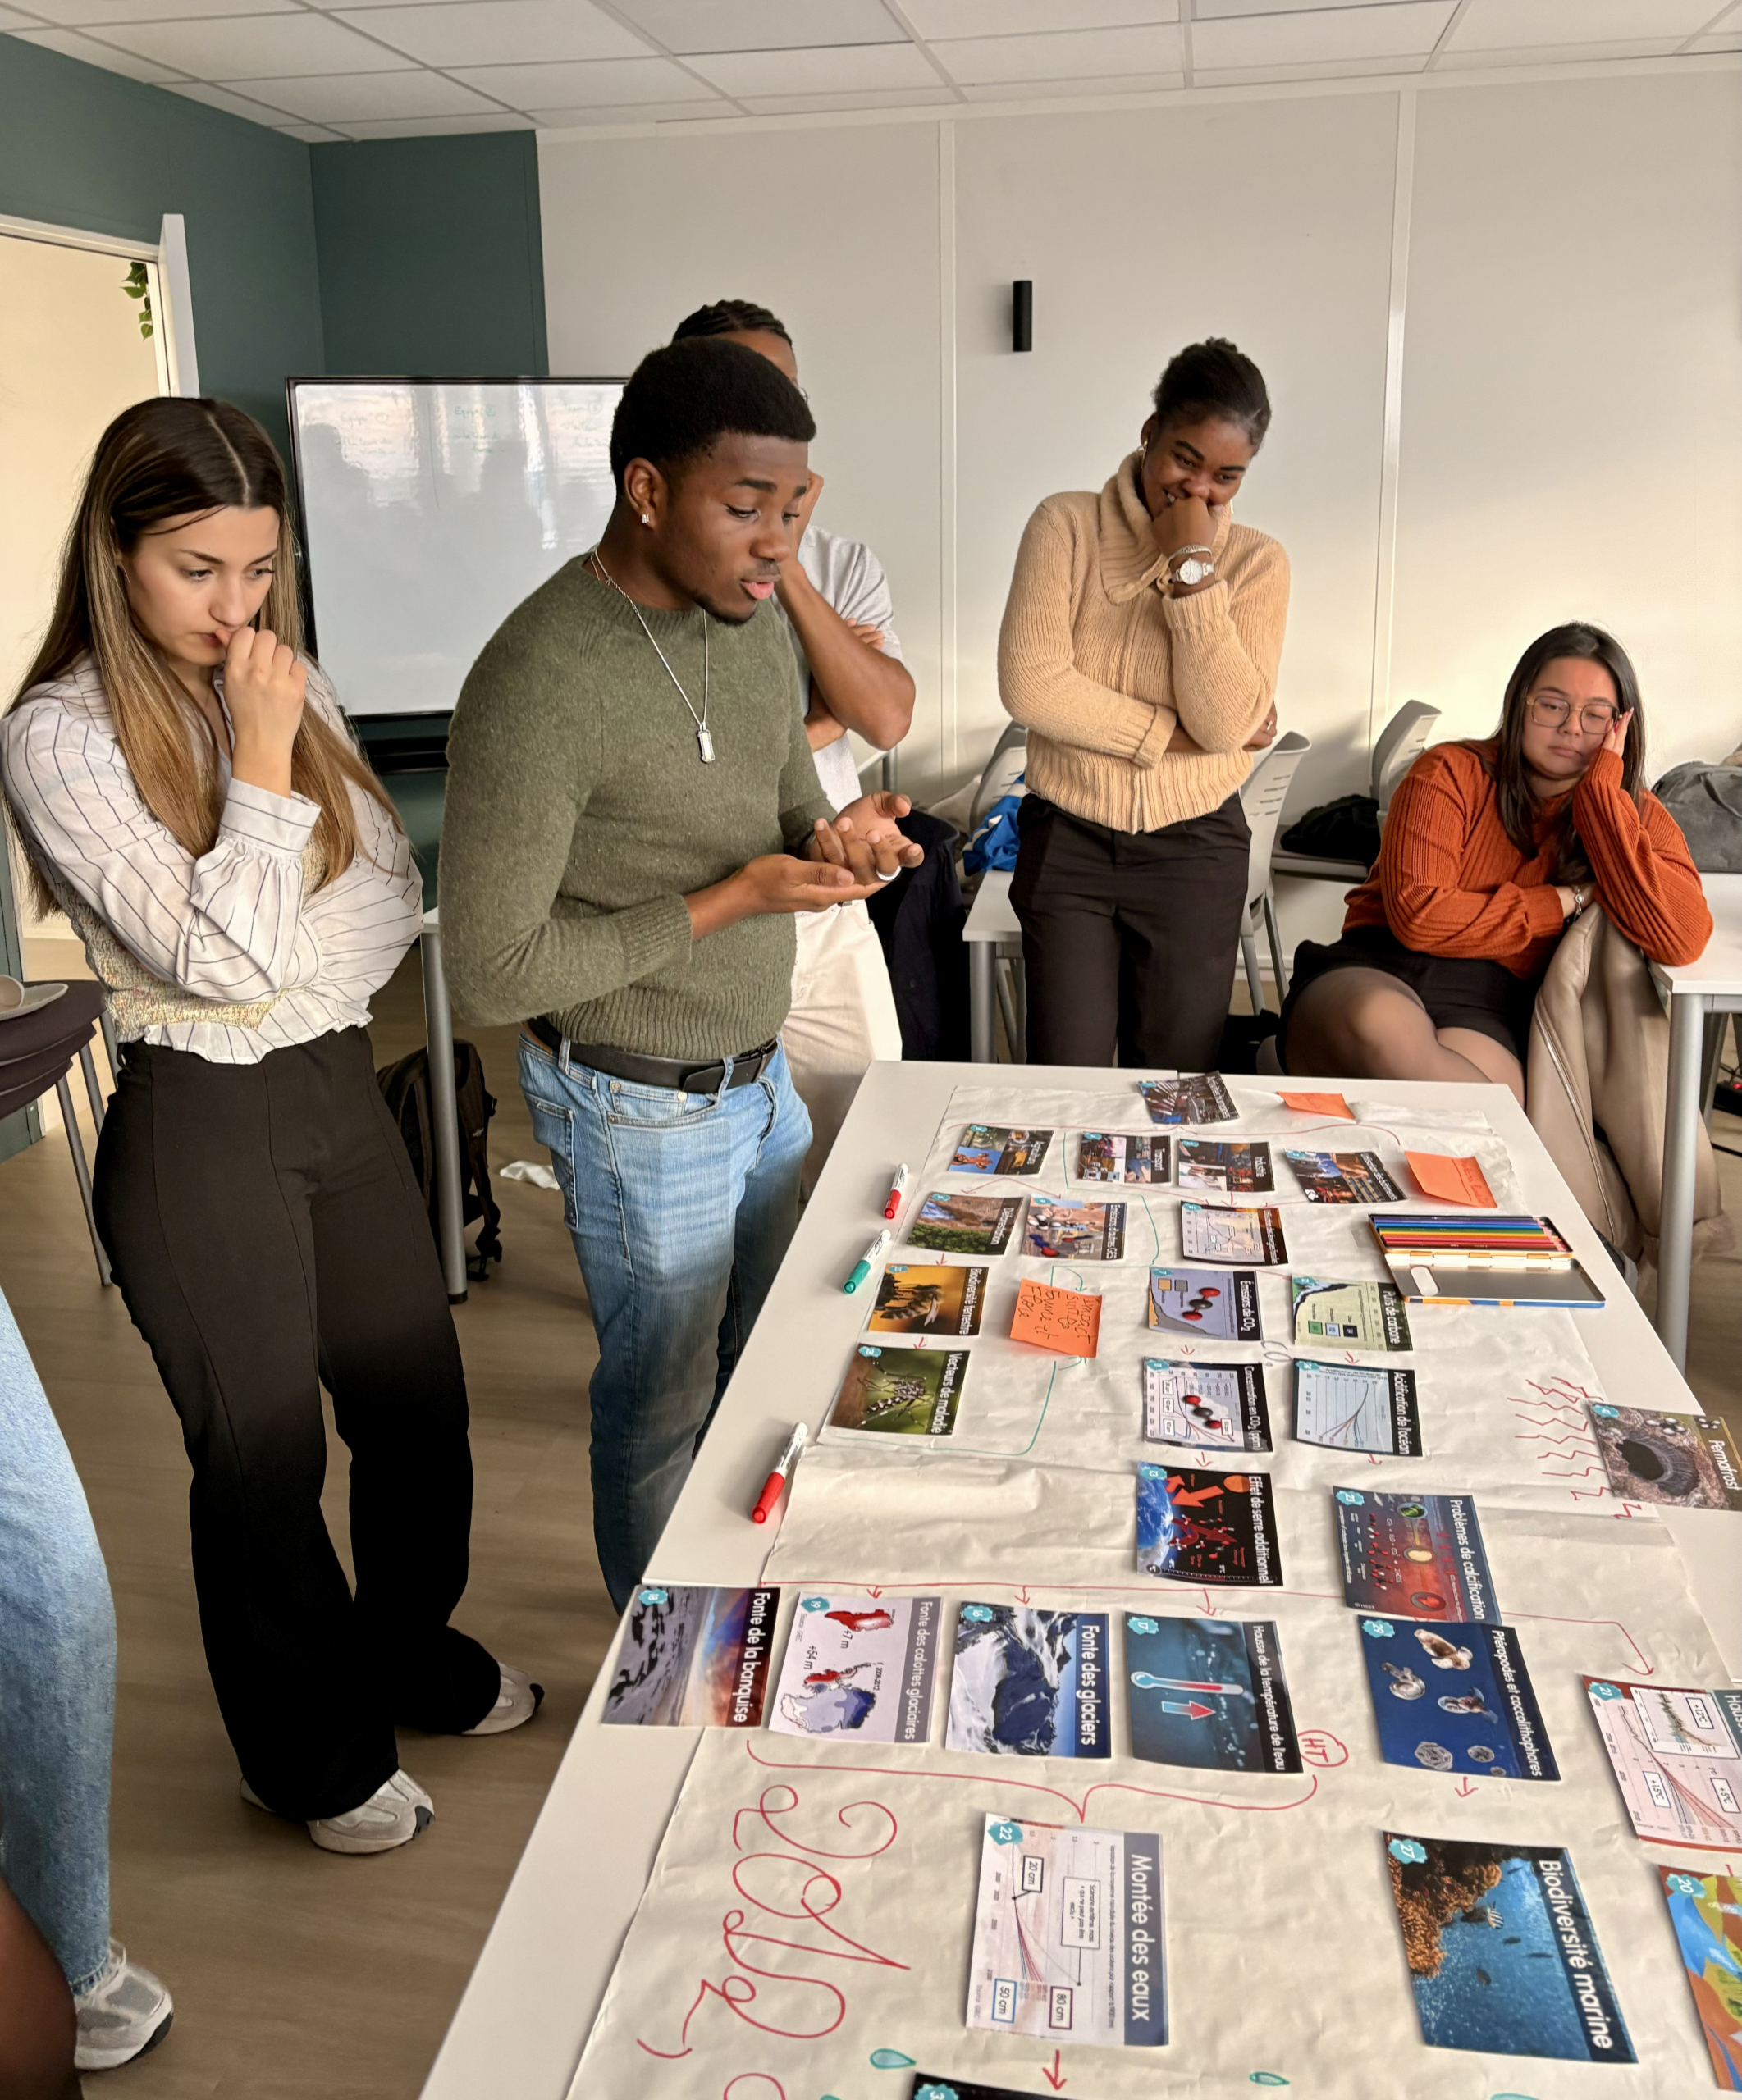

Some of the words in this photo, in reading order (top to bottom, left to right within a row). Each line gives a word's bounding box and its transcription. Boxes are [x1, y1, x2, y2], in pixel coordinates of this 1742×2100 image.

[1026, 1140, 1045, 1166] Agriculture
[1152, 1148, 1166, 1171] Transport
[1254, 1155, 1267, 1178] Industrie
[990, 1207, 1014, 1245] Déforestation
[1105, 1248, 1118, 1259] GES
[963, 1268, 982, 1305] Biodiversité
[1240, 1280, 1255, 1308] Émissions
[1383, 1290, 1396, 1307] Puits
[958, 1305, 975, 1335] terrestre
[1242, 1308, 1255, 1317] de
[1385, 1307, 1399, 1316] de
[1387, 1316, 1402, 1344] carbone
[942, 1352, 963, 1386] Vecteurs
[939, 1386, 956, 1399] de
[1244, 1366, 1258, 1406] Concentration
[1393, 1372, 1409, 1415] Acidification
[930, 1398, 951, 1434] maladie
[1397, 1415, 1411, 1427] de
[1397, 1427, 1412, 1455] l'océan
[1708, 1440, 1742, 1491] Permafrost
[1248, 1475, 1264, 1495] Effet
[1250, 1496, 1265, 1509] de
[1252, 1508, 1264, 1532] serre
[1450, 1499, 1468, 1545] Problèmes
[1254, 1532, 1274, 1585] additionnel
[1460, 1547, 1475, 1560] de
[1462, 1559, 1485, 1620] calcification
[749, 1592, 771, 1626] Fonte
[918, 1600, 933, 1627] Fonte
[972, 1609, 984, 1618] 16
[746, 1627, 766, 1644] de
[916, 1627, 930, 1646] des
[1081, 1624, 1100, 1661] Fonte
[1252, 1625, 1266, 1655] Hausse
[743, 1646, 764, 1660] la
[1257, 1655, 1270, 1667] de
[1492, 1629, 1516, 1682] Ptéropodes
[910, 1646, 928, 1687] calottes
[1081, 1662, 1101, 1687] des
[1259, 1667, 1272, 1678] la
[731, 1661, 761, 1723] banquise
[1506, 1682, 1518, 1696] et
[1598, 1685, 1613, 1697] 21
[903, 1687, 924, 1741] glaciaires
[1075, 1689, 1102, 1746] glaciers
[1260, 1678, 1278, 1732] température
[1270, 1732, 1285, 1746] de
[1509, 1694, 1543, 1778] coccolithophores
[1273, 1746, 1287, 1771] l'eau
[999, 1825, 1013, 1841] 22
[1399, 1843, 1416, 1860] 27
[1028, 1860, 1038, 1872] 20
[1028, 1872, 1036, 1885] cm
[1131, 1854, 1154, 1925] Montée
[1677, 1877, 1694, 1894] 20
[1131, 1929, 1155, 1965] des
[1539, 1859, 1594, 1970] Biodiversité
[1573, 1973, 1614, 2050] marine
[999, 1985, 1011, 1999] 50
[1056, 1993, 1067, 2006] 80
[1131, 1970, 1150, 2022] eaux
[998, 1998, 1008, 2015] cm
[1055, 2006, 1064, 2021] cm
